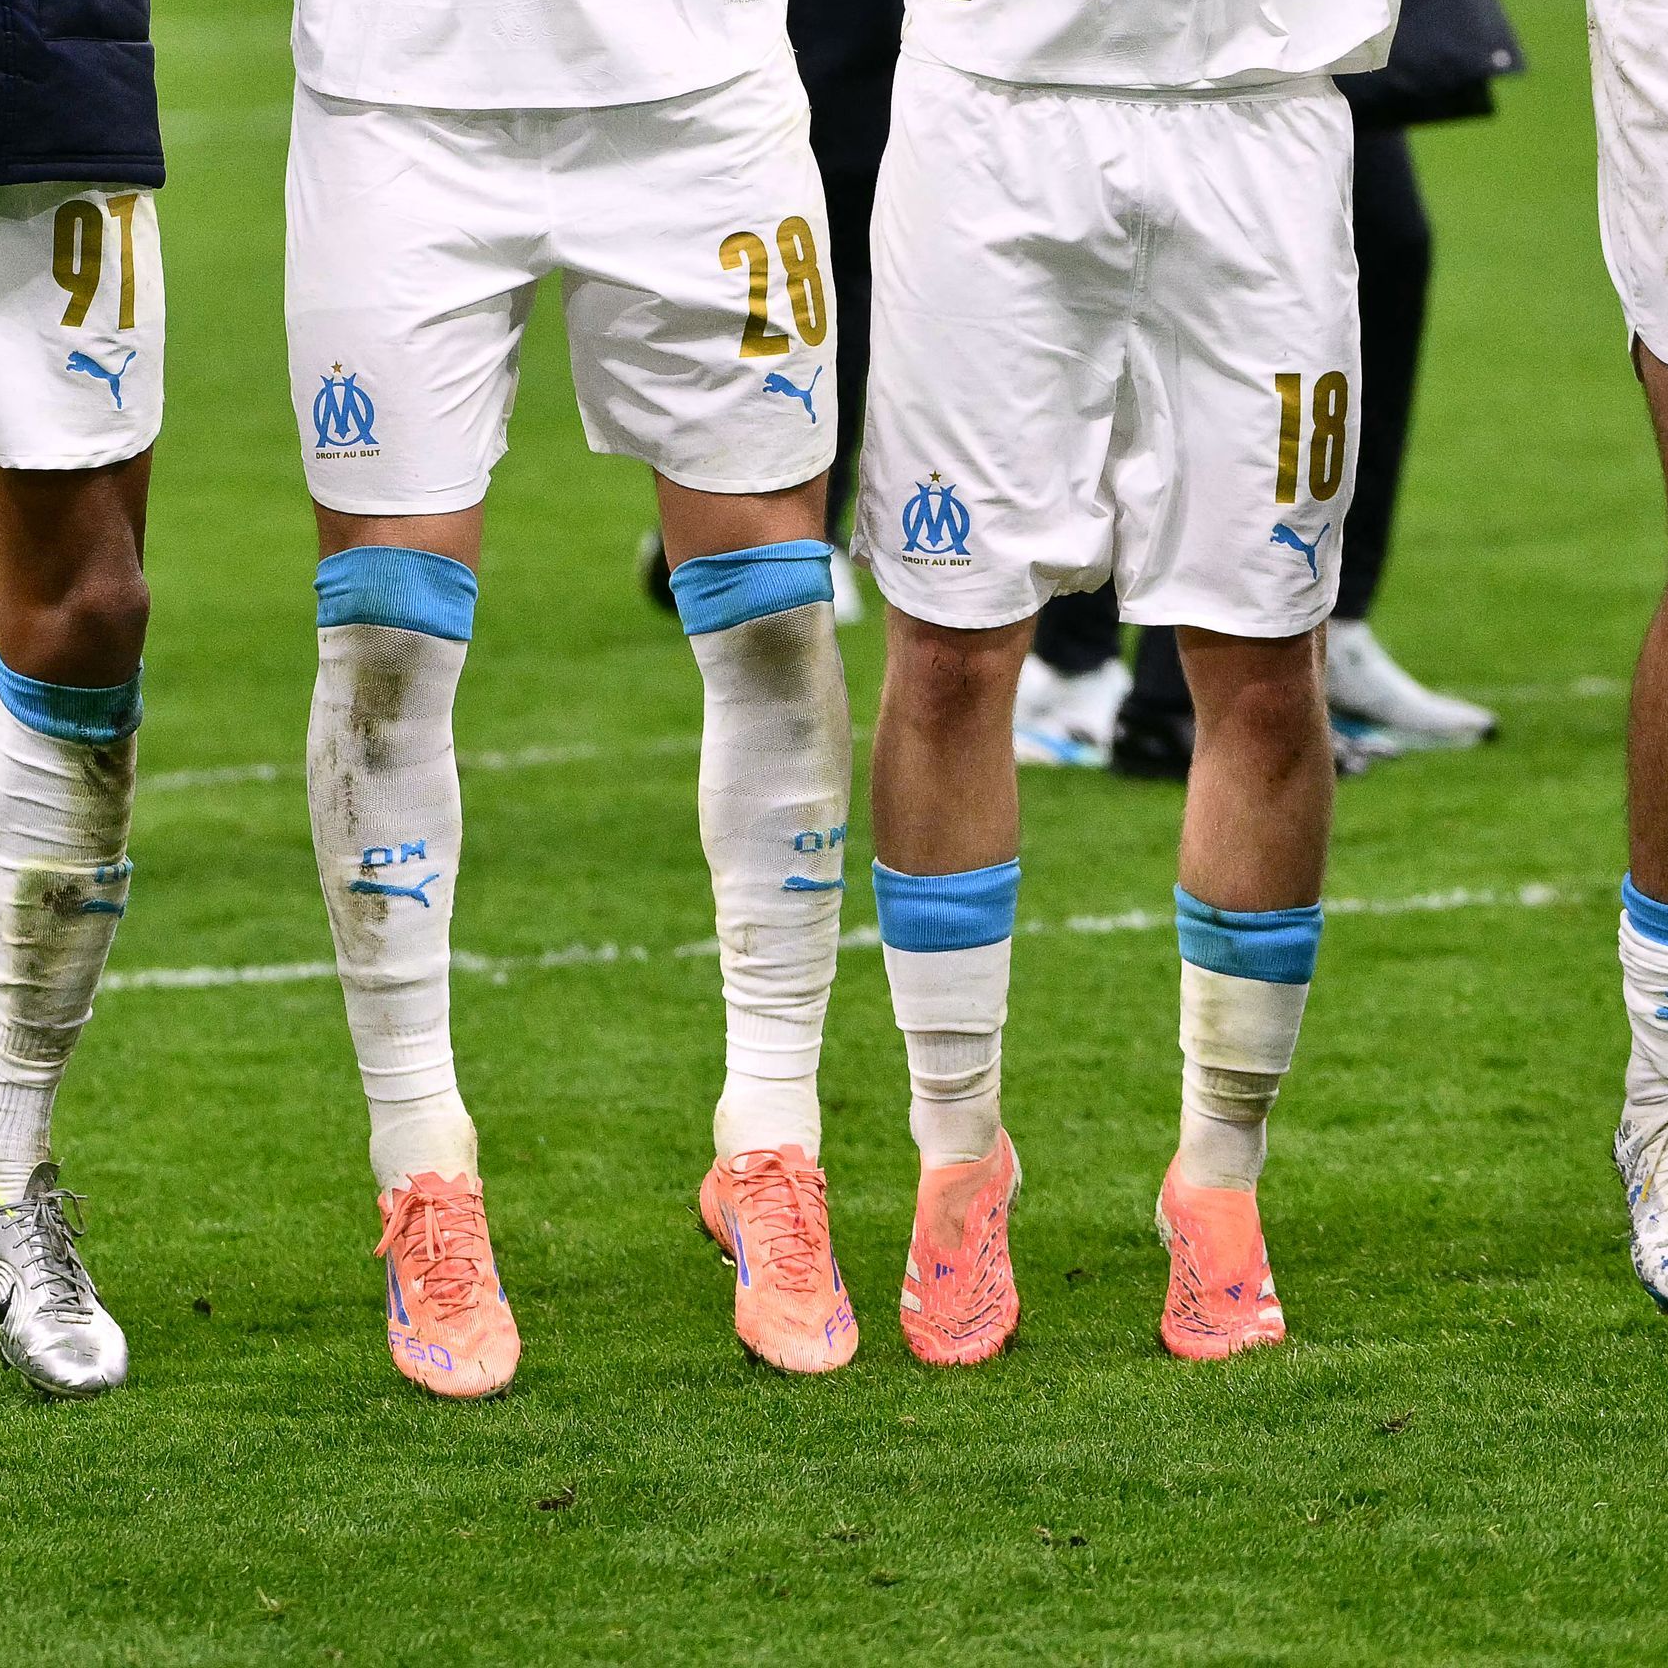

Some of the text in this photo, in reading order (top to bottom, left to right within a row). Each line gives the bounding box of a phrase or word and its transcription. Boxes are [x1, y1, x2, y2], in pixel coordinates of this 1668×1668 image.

[52, 194, 138, 330] 91
[718, 216, 826, 359] 28
[315, 452, 341, 460] DROIT
[359, 449, 381, 457] BUT
[1274, 371, 1349, 504] 18
[902, 555, 930, 565] DROIT
